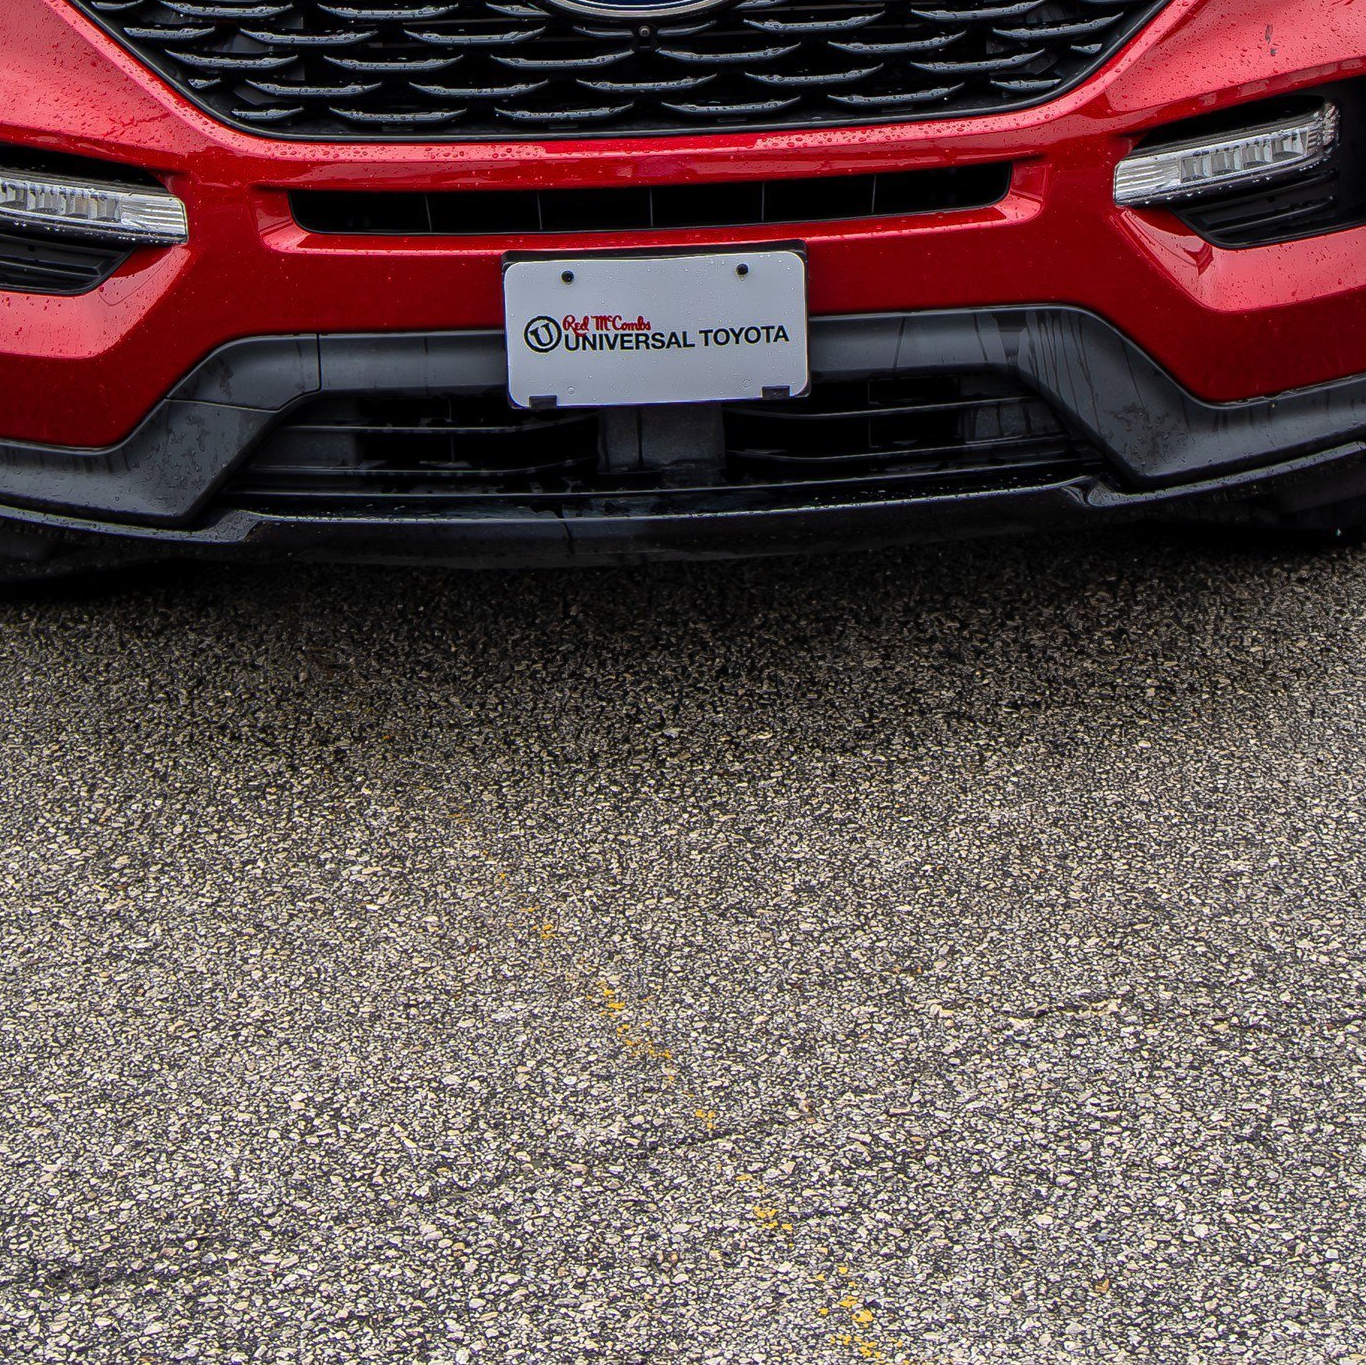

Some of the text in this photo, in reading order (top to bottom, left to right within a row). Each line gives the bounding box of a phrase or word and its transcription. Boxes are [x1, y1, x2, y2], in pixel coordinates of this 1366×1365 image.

[562, 314, 651, 337] Red McCombs
[564, 324, 790, 352] UNIVERSAL TOYOTA
